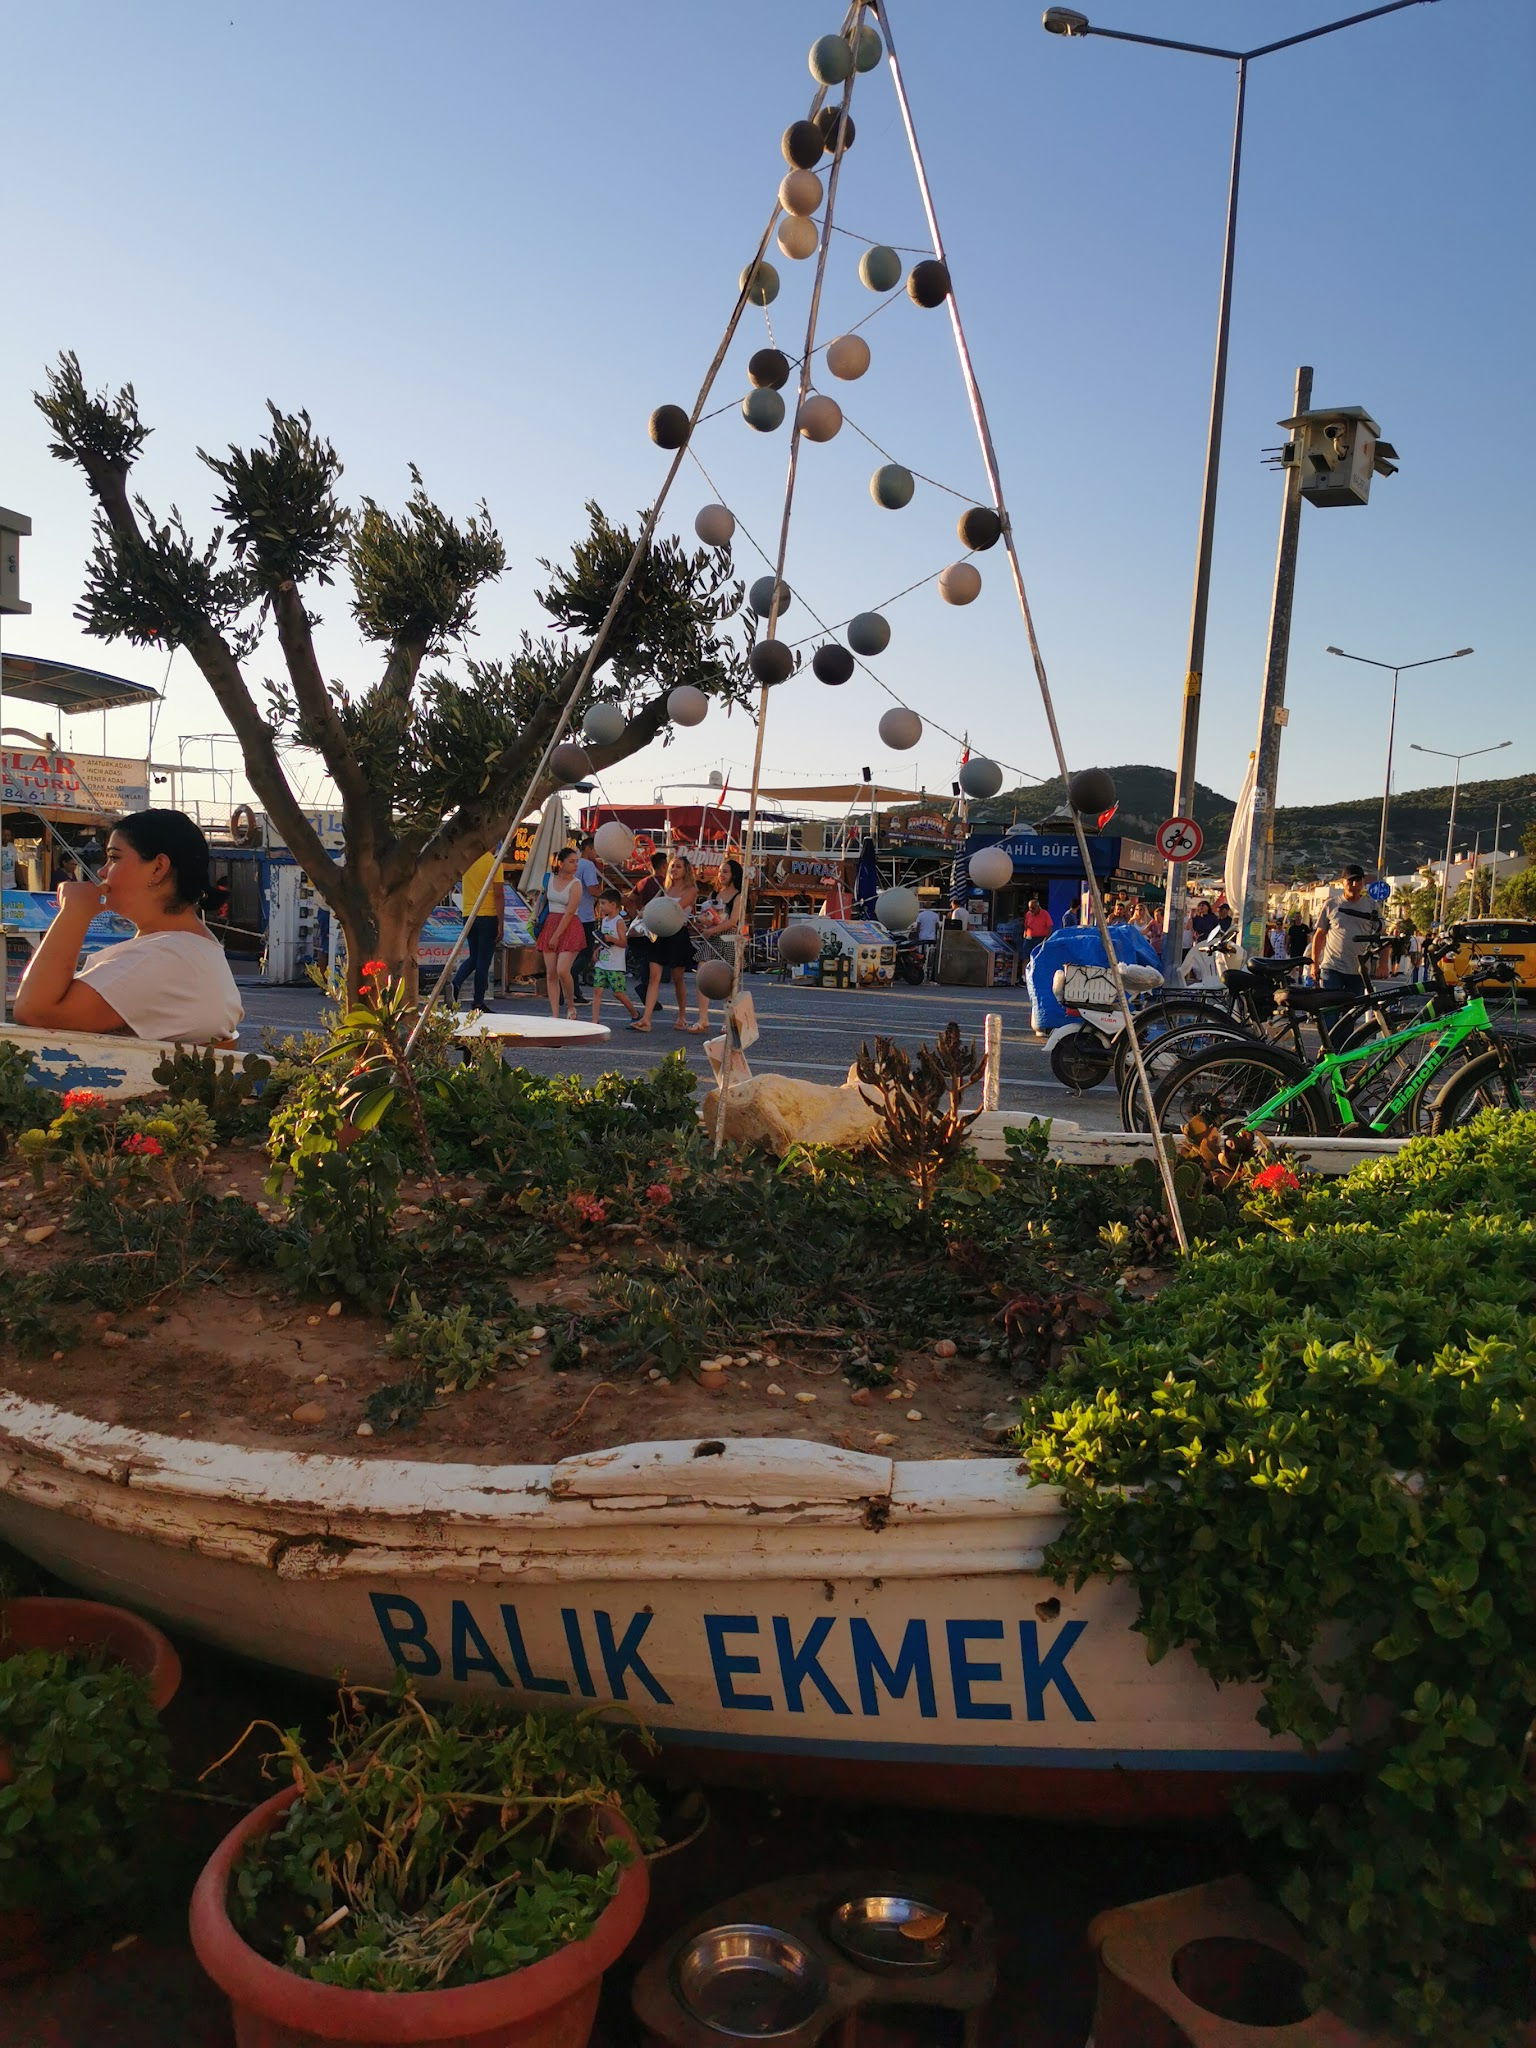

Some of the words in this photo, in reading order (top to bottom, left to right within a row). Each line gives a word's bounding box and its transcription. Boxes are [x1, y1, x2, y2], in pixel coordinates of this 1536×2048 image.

[20, 775, 80, 791] TURU
[5, 788, 23, 799] 84
[29, 790, 46, 801] 61
[54, 792, 71, 803] 22
[1041, 842, 1079, 857] BÜFE
[791, 860, 838, 877] POYRAZ
[1389, 1052, 1442, 1114] Bianchi
[368, 1592, 675, 1706] BALIK
[703, 1614, 1097, 1723] EKMEK
